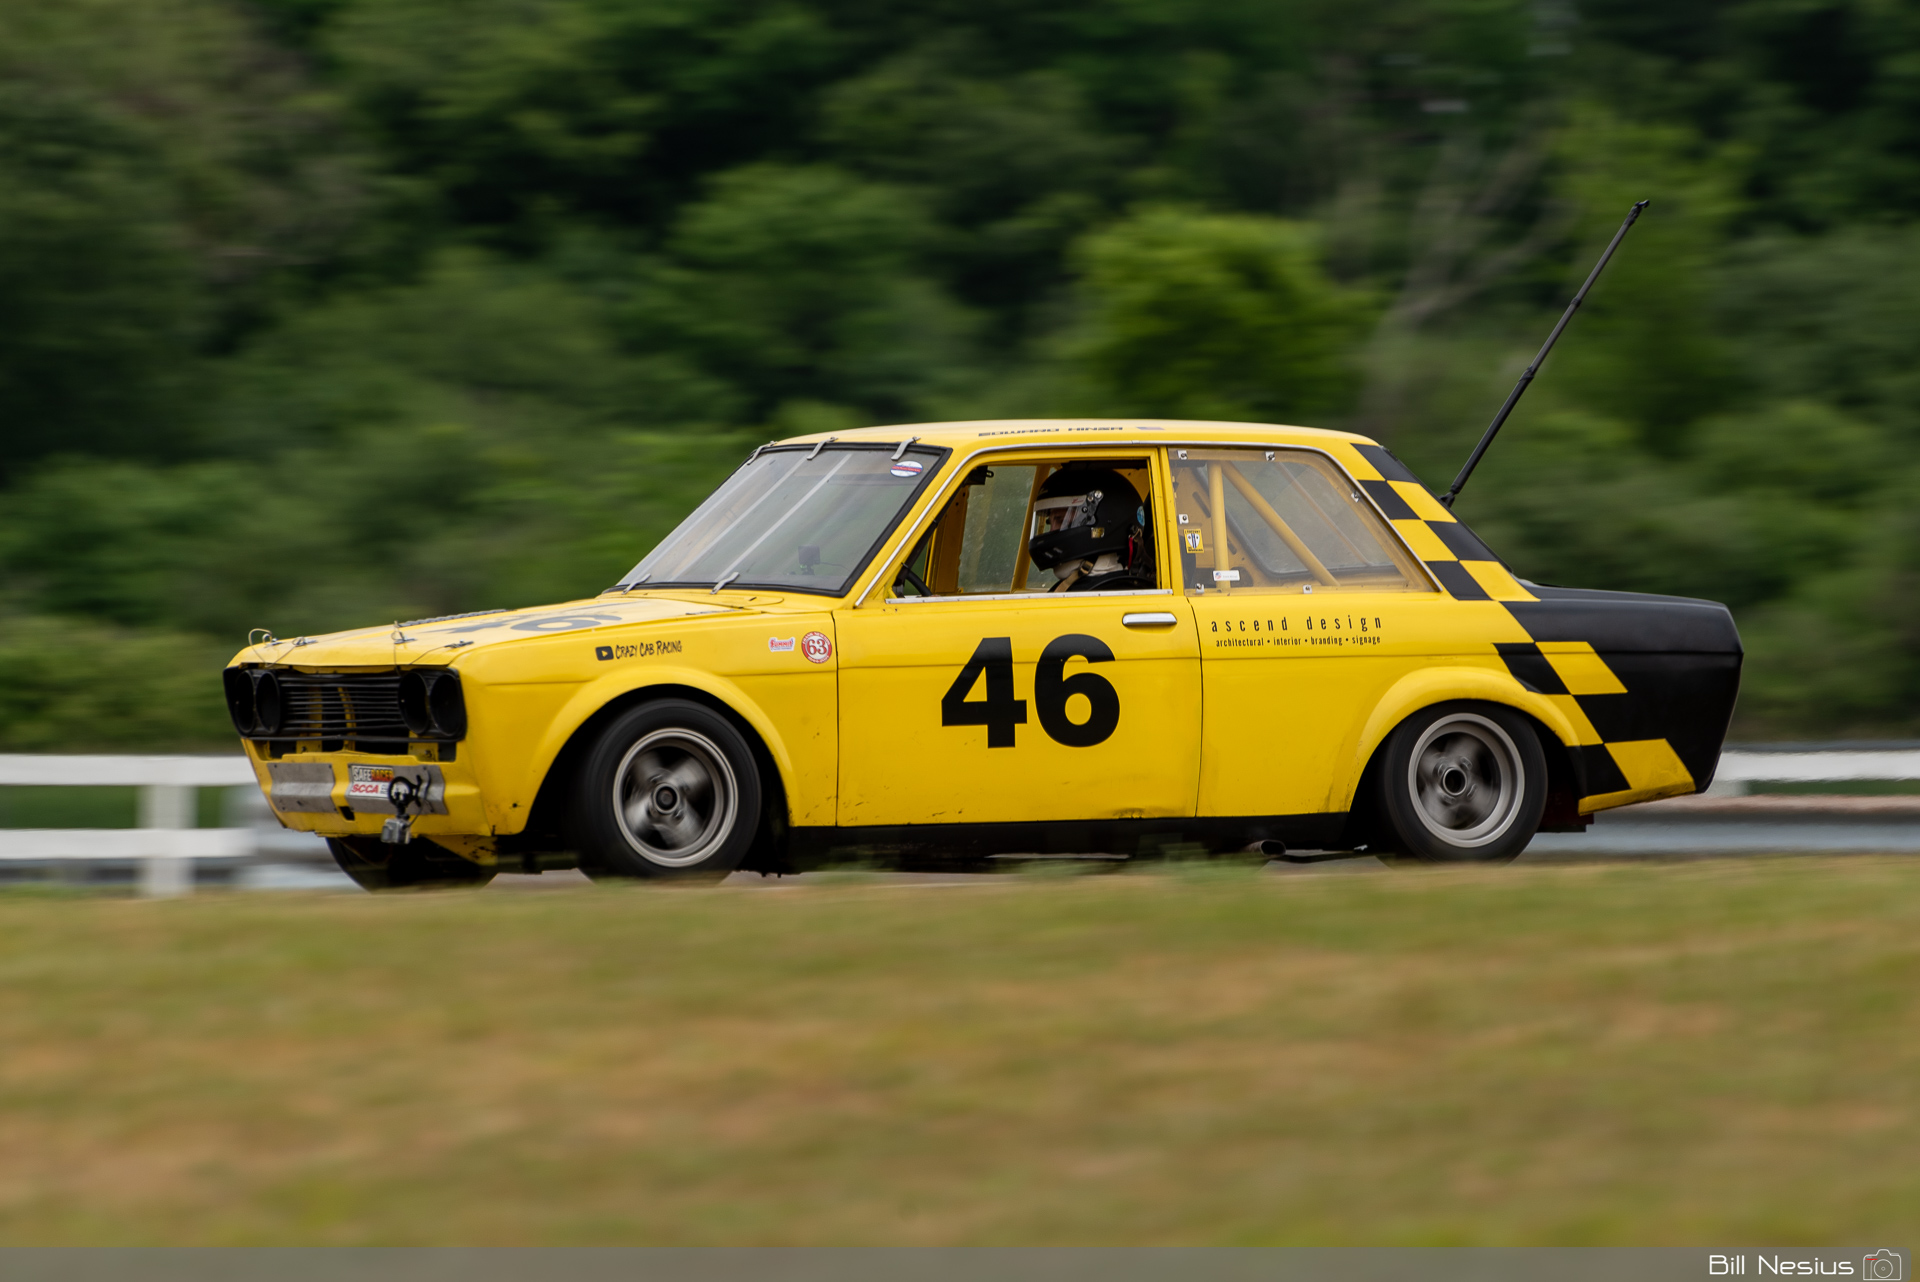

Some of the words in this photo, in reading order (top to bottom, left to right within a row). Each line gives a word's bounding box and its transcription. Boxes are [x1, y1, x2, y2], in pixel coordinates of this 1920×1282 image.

[1211, 616, 1288, 633] ascend
[1306, 614, 1382, 632] design
[806, 638, 828, 656] 63
[1216, 637, 1264, 648] architectural
[1273, 636, 1301, 646] interior
[1310, 635, 1343, 647] branding
[1352, 634, 1381, 646] signage
[941, 633, 1121, 749] 46
[351, 783, 380, 795] SCCA
